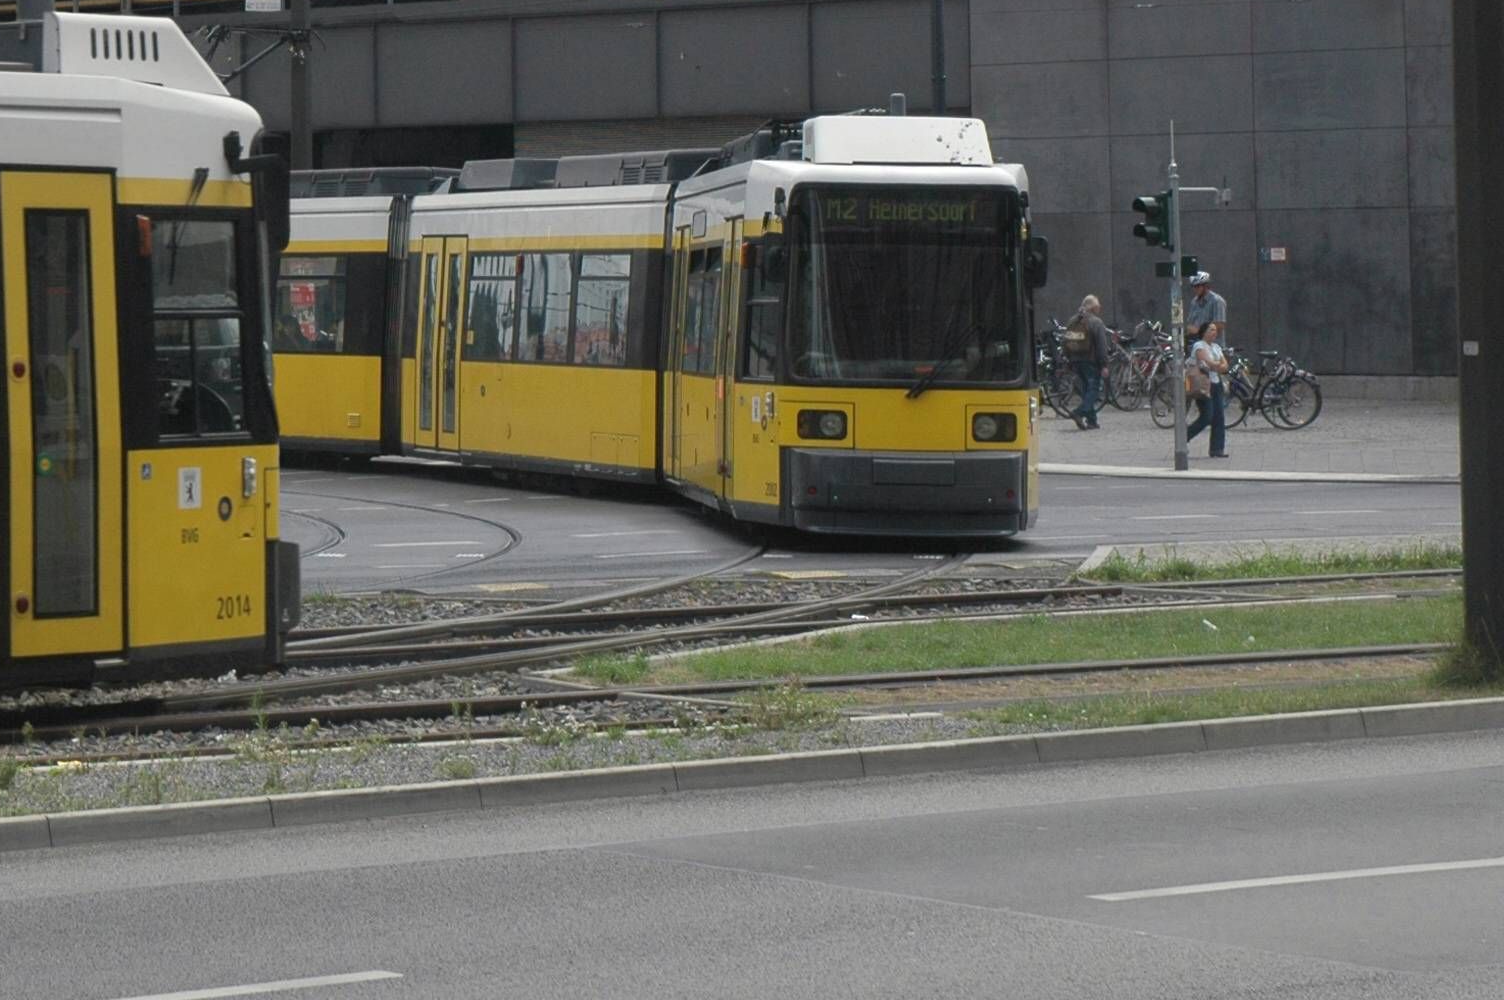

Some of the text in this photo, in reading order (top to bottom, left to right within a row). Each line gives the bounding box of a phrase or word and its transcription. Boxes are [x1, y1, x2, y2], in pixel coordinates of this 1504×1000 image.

[826, 199, 977, 221] M2 Heinersdorf
[216, 595, 251, 620] 2014
